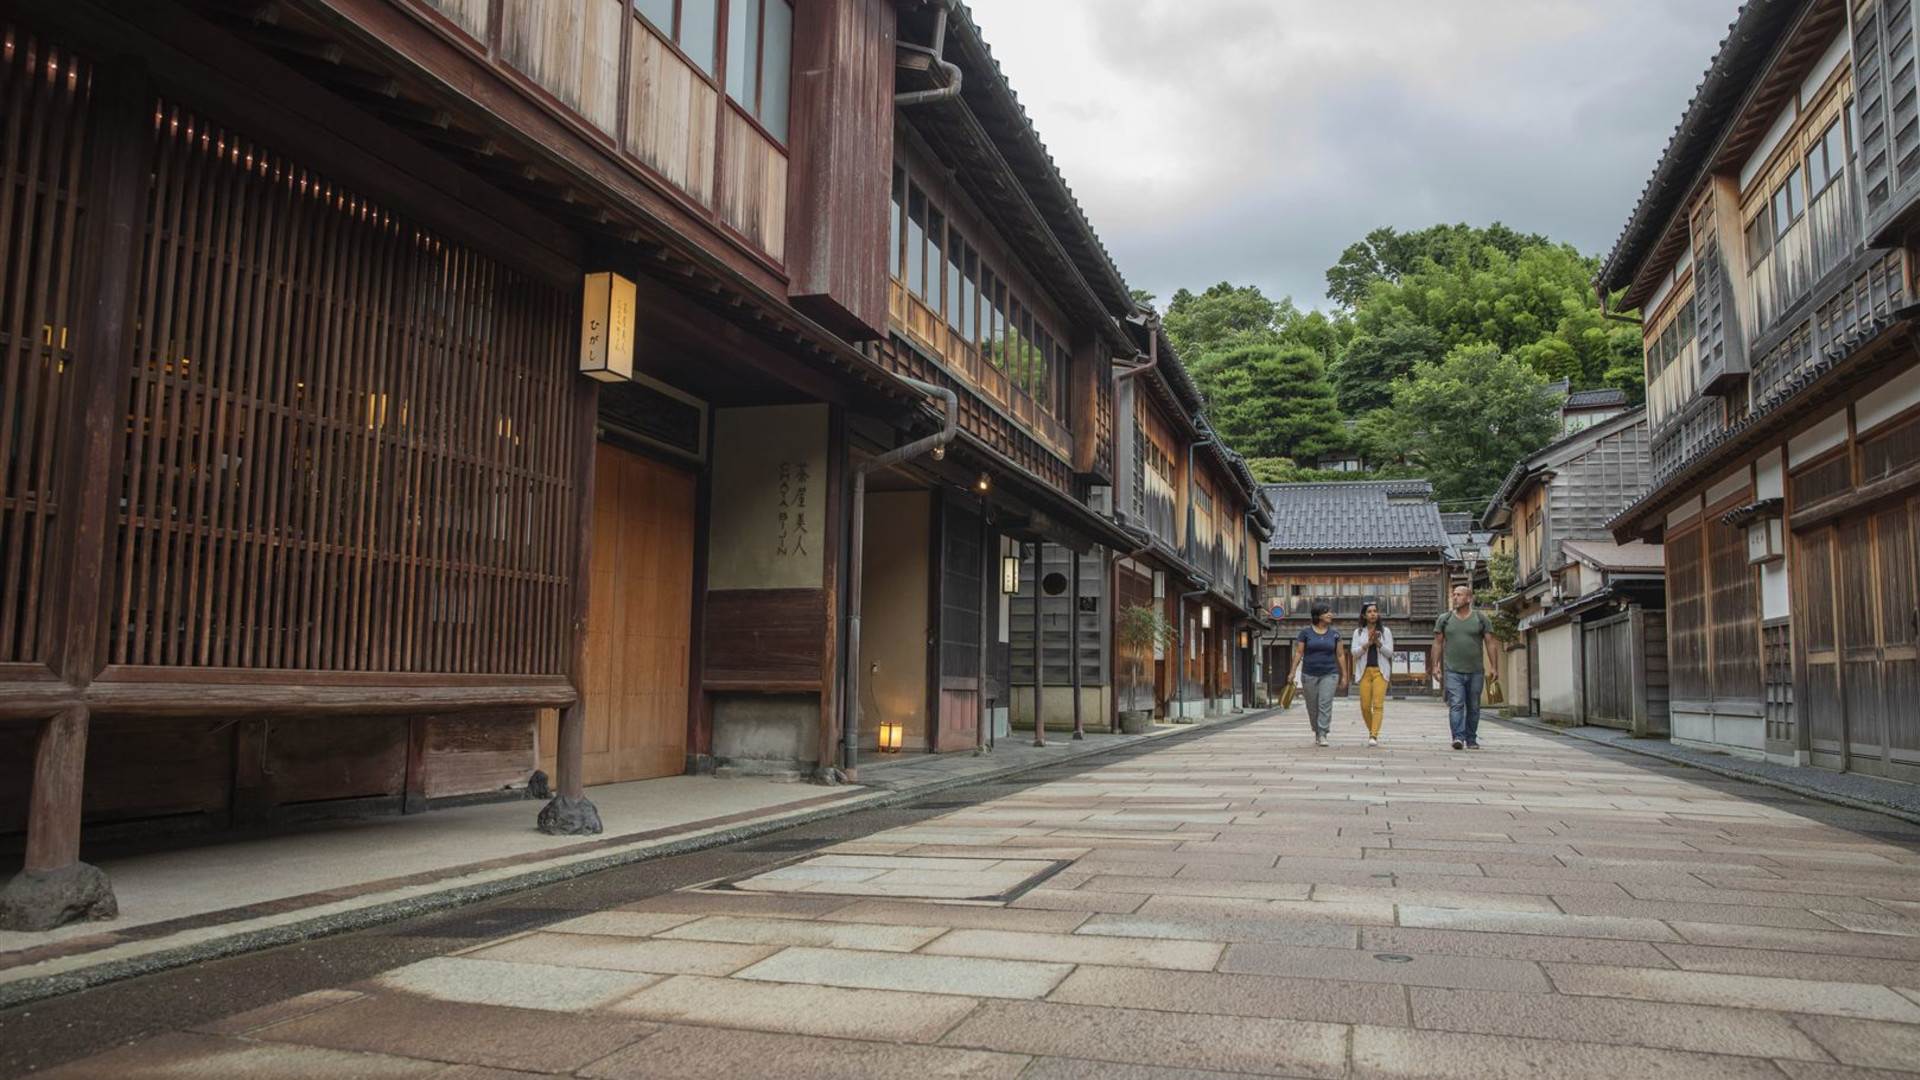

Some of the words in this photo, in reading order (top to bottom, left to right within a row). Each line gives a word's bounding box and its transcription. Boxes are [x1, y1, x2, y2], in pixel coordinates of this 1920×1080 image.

[589, 320, 600, 361] ひがし
[779, 462, 790, 508] CHAYA
[791, 462, 810, 556] 茶屋美人
[777, 511, 789, 556] BIJIN
